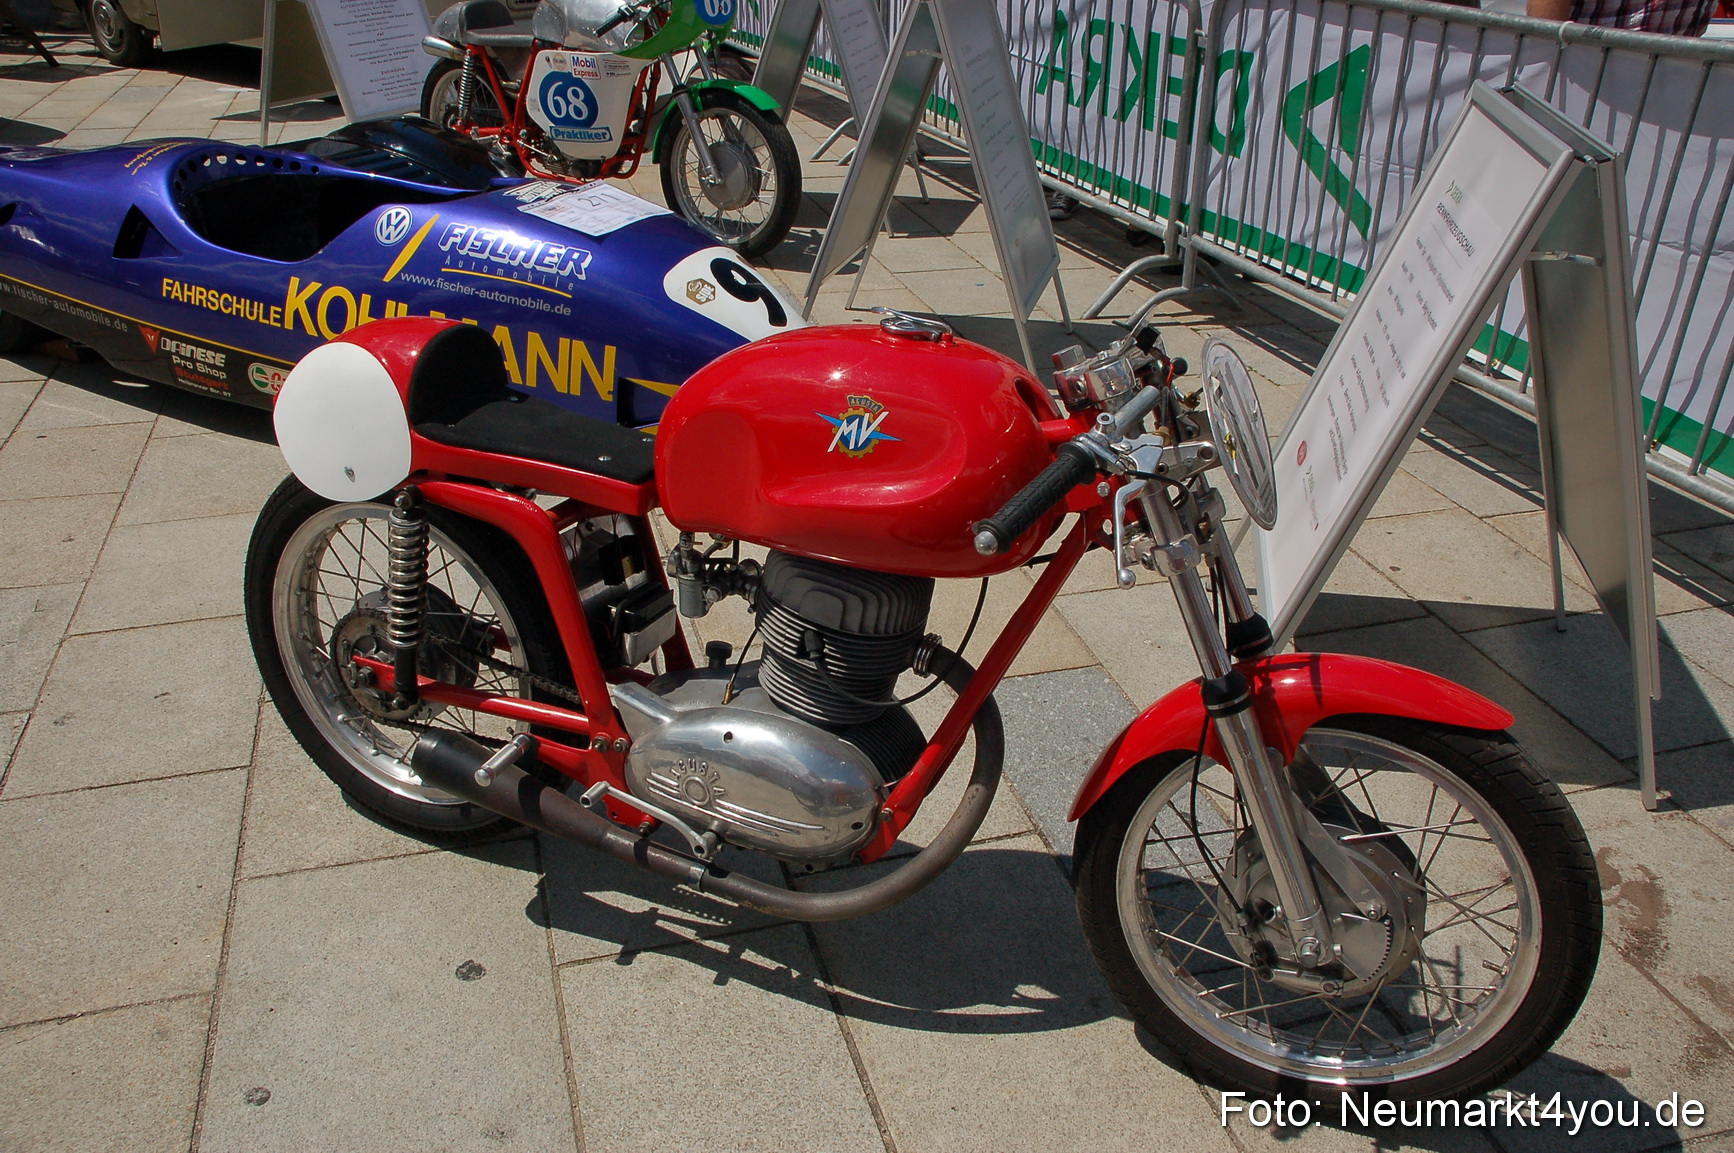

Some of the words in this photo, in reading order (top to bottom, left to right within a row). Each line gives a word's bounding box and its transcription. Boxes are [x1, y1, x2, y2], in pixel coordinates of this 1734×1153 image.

[572, 56, 596, 68] Mobil
[574, 68, 598, 77] Express
[547, 82, 588, 120] 68
[555, 128, 607, 140] Praktiker
[578, 193, 620, 207] 271
[375, 206, 412, 246] VW
[1436, 202, 1475, 257] RENNFAHRZEUGSCHAU
[438, 222, 592, 280] FISCHER
[445, 255, 574, 291] Automobile
[0, 280, 128, 332] w.fischer-automobile.de
[400, 272, 571, 316] www.fischer-automobile.de
[162, 277, 282, 328] FAHRSCHULE
[284, 276, 617, 402] KOANN
[172, 354, 195, 371] Pro
[197, 362, 227, 379] Shop
[175, 366, 229, 390] Stuttgart
[849, 397, 880, 413] AGUSTA
[827, 411, 889, 453] MV
[670, 758, 726, 796] AGUSTA
